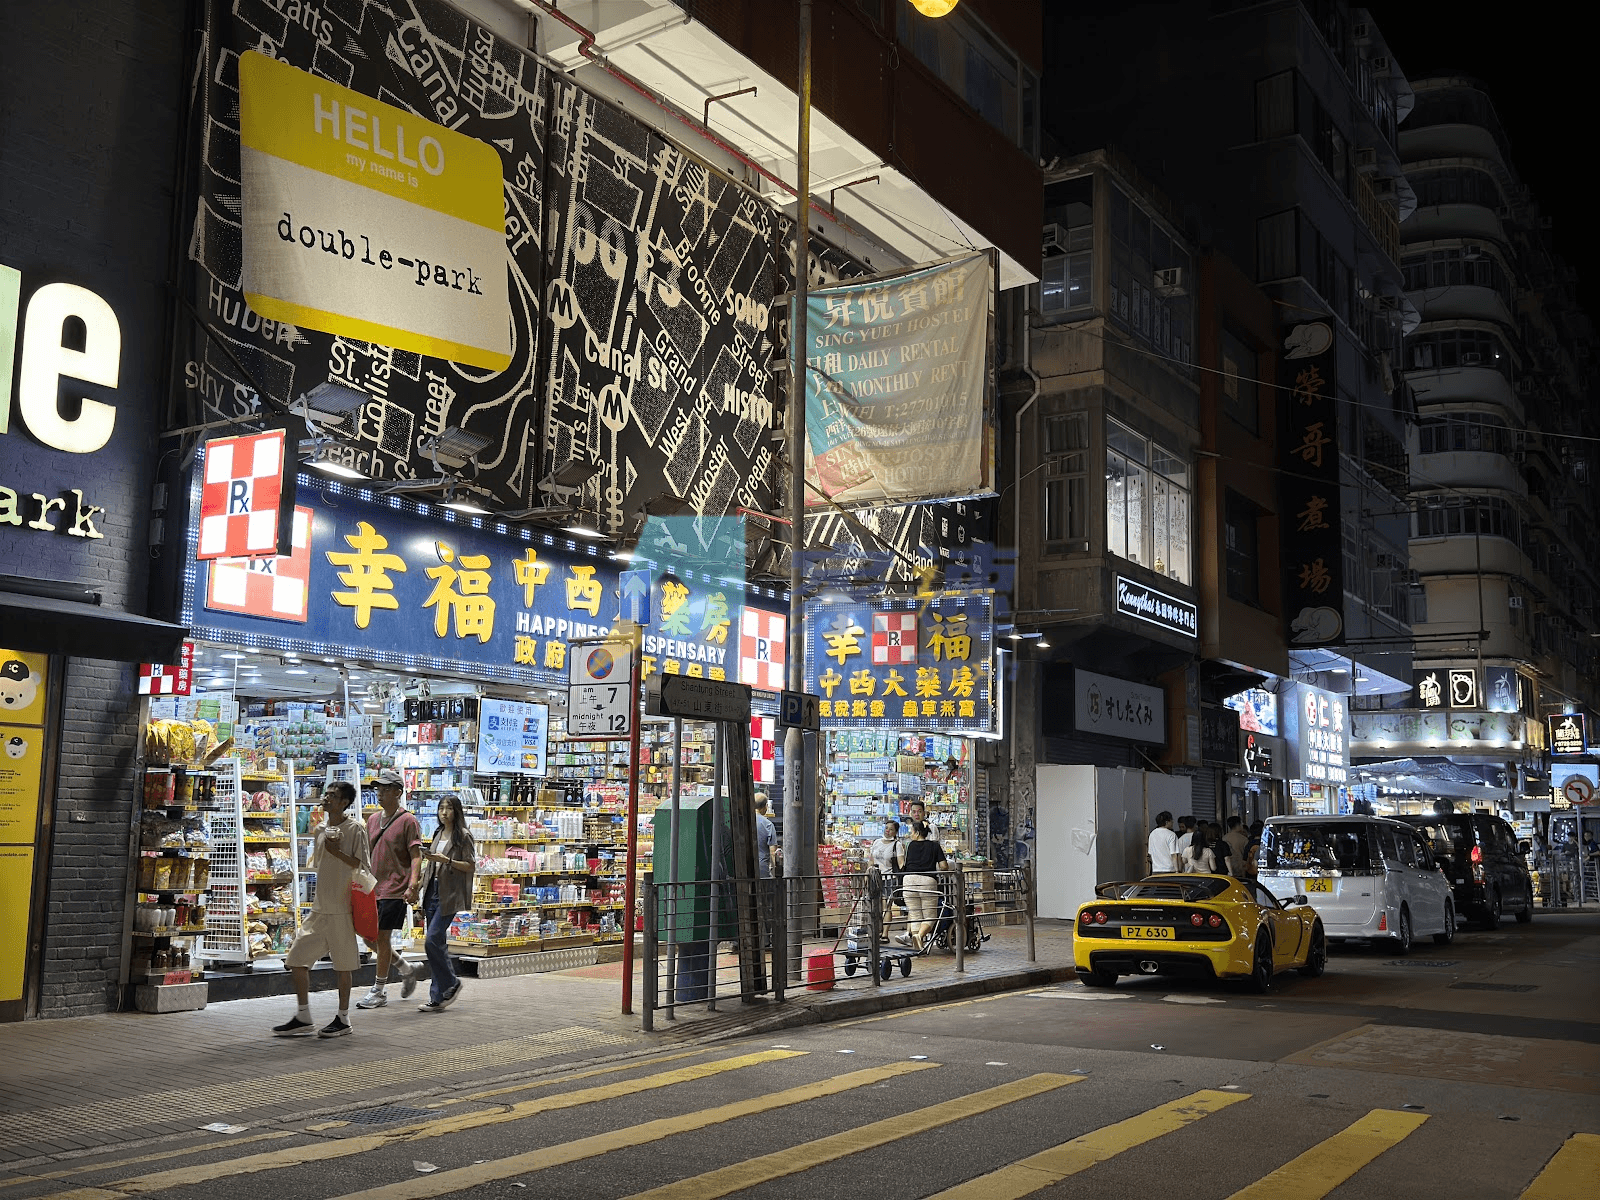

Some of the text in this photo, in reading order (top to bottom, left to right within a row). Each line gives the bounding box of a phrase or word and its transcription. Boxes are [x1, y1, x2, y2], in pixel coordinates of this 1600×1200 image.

[313, 93, 446, 177] HELLO
[346, 152, 419, 188] my name is
[278, 213, 484, 296] double-park
[675, 238, 769, 393] Broome Street
[815, 307, 973, 349] SING YUET HOSTEL
[329, 341, 360, 384] St.
[655, 330, 698, 395] Grand
[848, 336, 960, 372] DAILY RENTAL
[850, 360, 970, 398] MONTHLY RENT
[658, 407, 690, 460] West
[689, 435, 730, 512] Wooster
[737, 446, 772, 507] Greene
[325, 521, 731, 644] 幸福 中西藥房
[642, 633, 727, 665] ISPENSARY
[579, 694, 597, 704] 上午
[607, 687, 618, 704] 7
[715, 685, 735, 698] Street
[818, 666, 976, 698] 中西大藥房
[572, 713, 626, 731] midnight 12
[579, 722, 596, 731] 午夜
[787, 698, 798, 721] P
[1127, 928, 1168, 938] PZ 630
